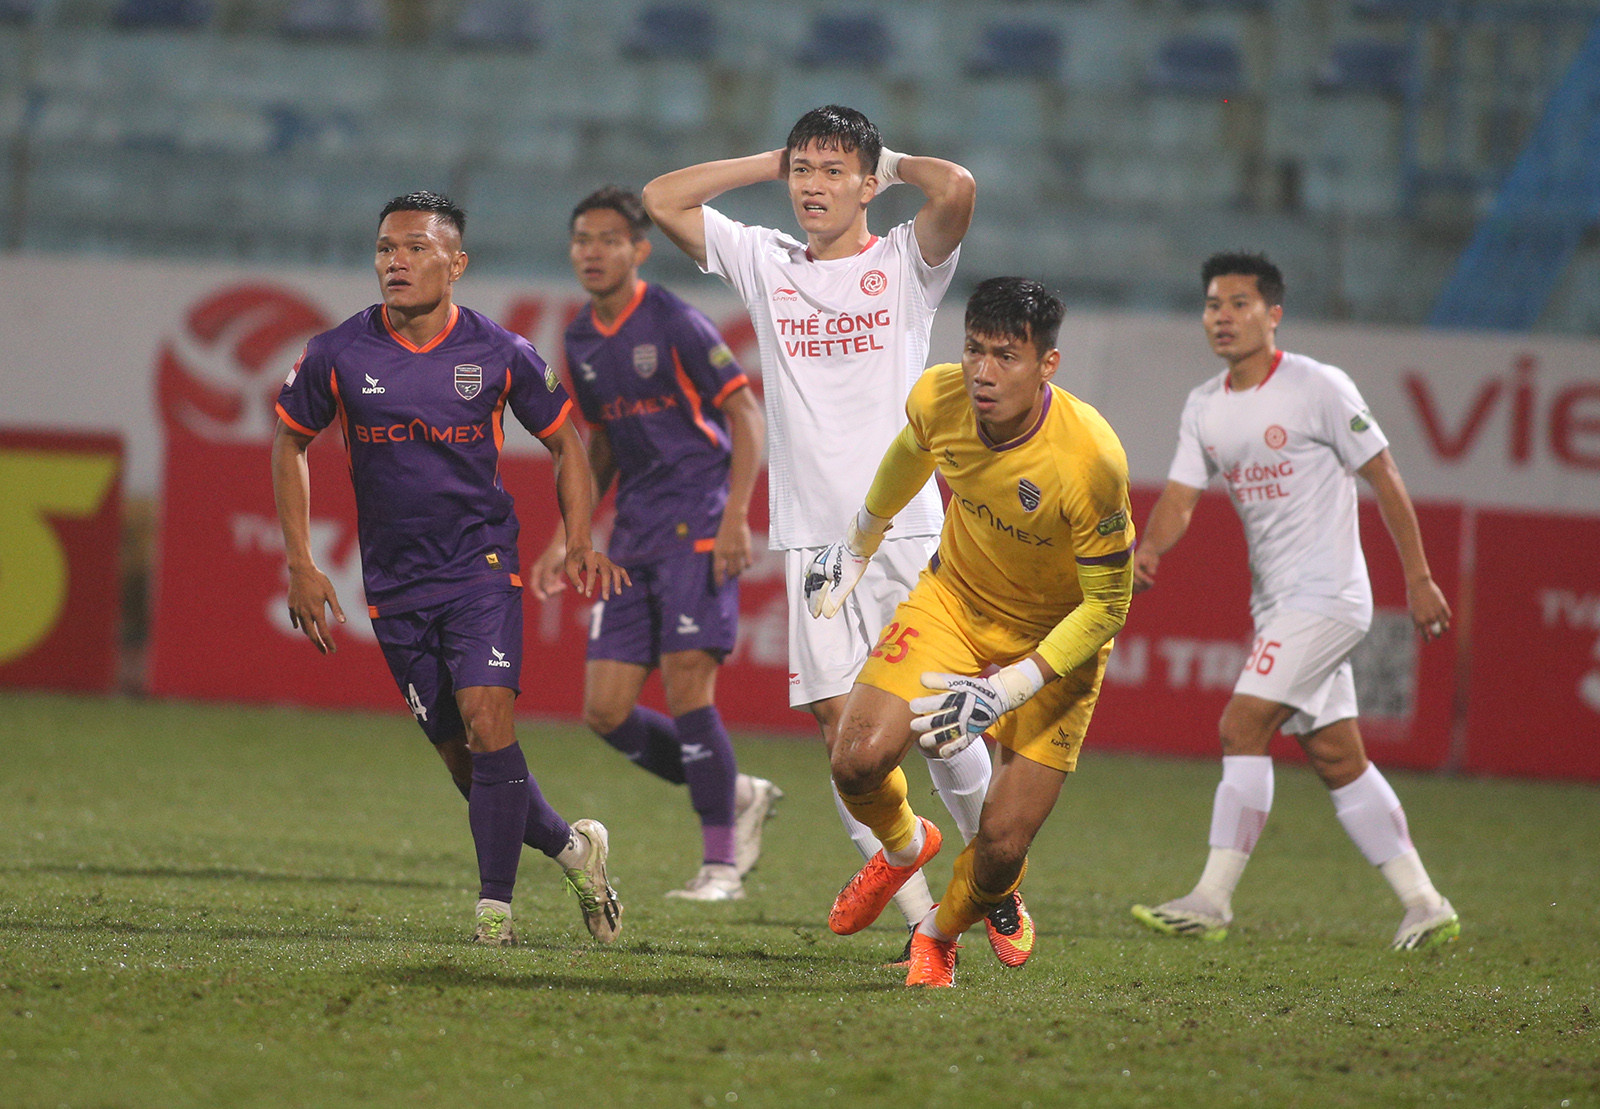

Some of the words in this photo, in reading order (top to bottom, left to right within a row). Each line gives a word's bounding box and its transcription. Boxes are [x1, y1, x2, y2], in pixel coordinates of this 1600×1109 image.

[776, 308, 822, 336] THỂ
[825, 309, 890, 335] CÔNG
[785, 334, 884, 357] VIETTEL
[1235, 483, 1290, 503] ETTEL
[871, 622, 919, 664] 25
[405, 682, 428, 721] 4
